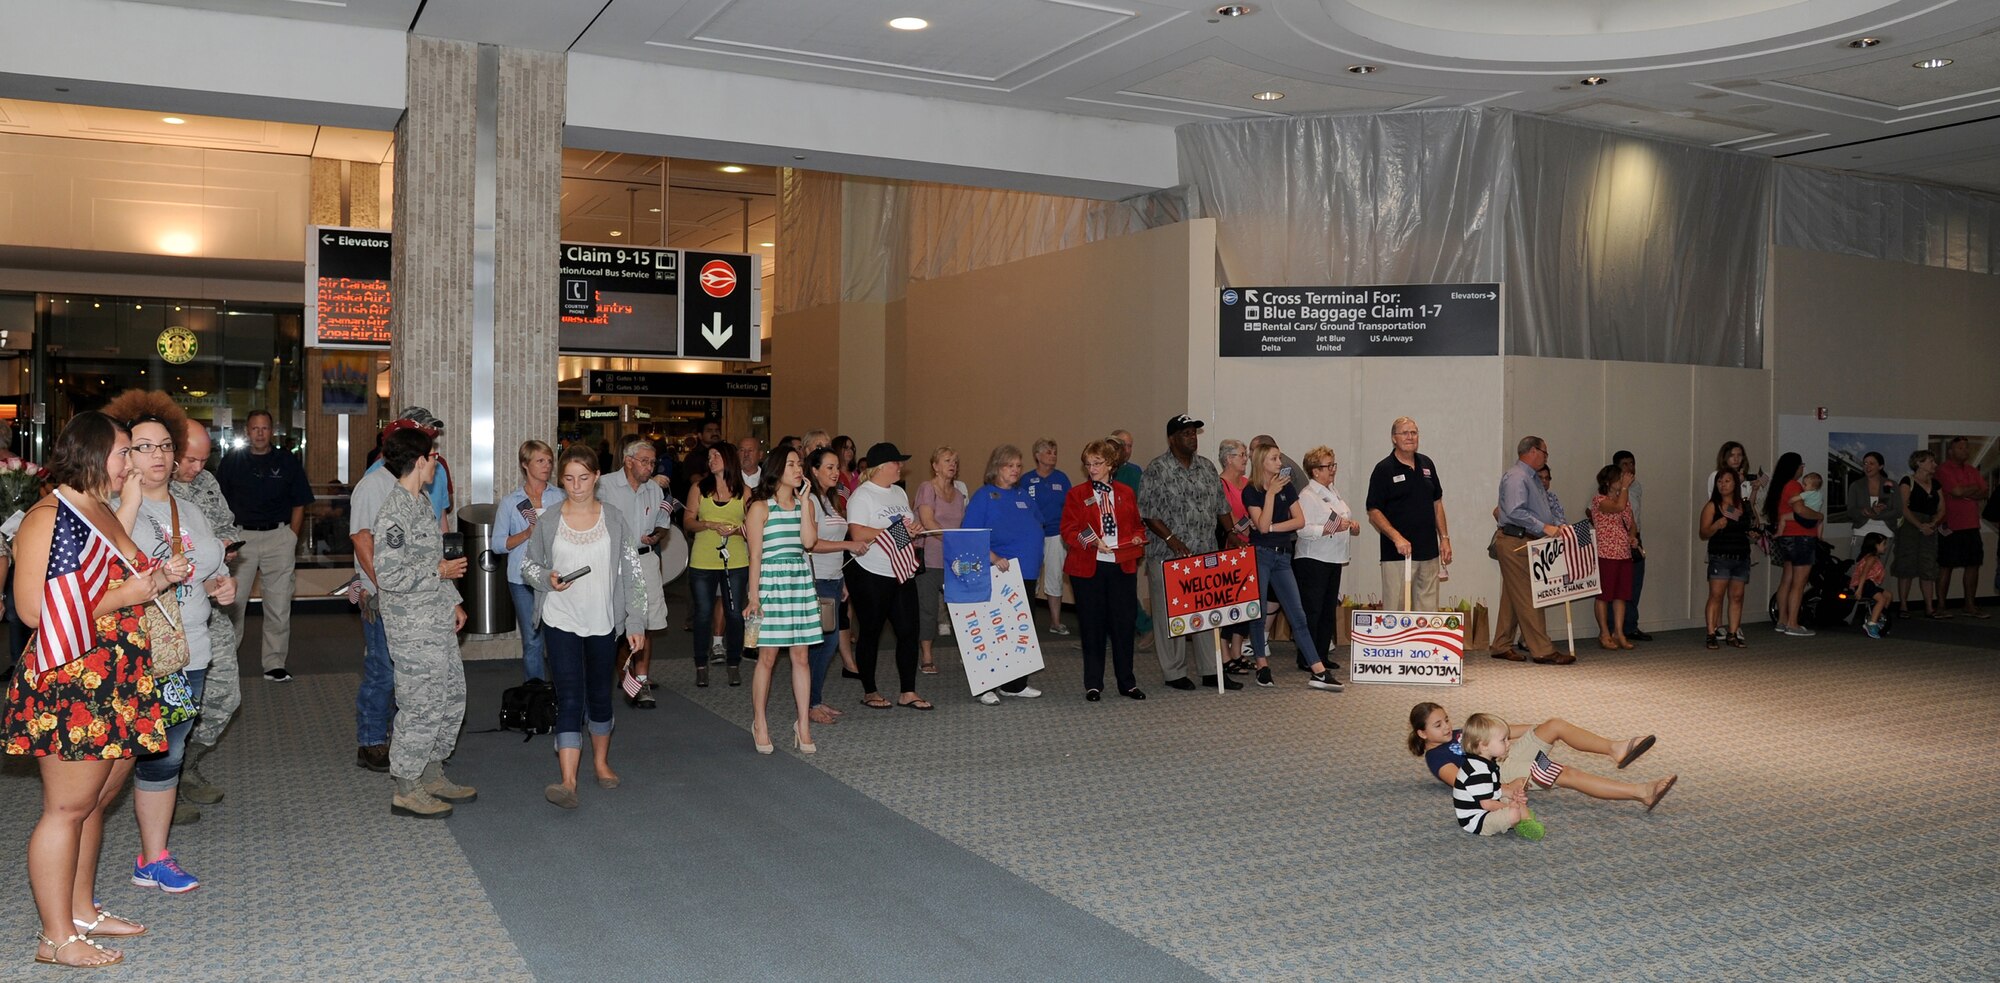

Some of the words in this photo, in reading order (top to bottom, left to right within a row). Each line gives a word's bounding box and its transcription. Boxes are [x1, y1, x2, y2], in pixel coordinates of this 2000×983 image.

[338, 235, 390, 249] Elevators
[566, 246, 612, 264] Claim
[616, 249, 651, 266] 9-15
[604, 268, 620, 278] Bus
[621, 269, 651, 280] Service
[318, 276, 338, 289] Air
[340, 277, 387, 291] Canada
[318, 289, 363, 302] Alaska
[1262, 291, 1302, 305] Cross
[1305, 290, 1368, 305] Terminal
[1373, 290, 1401, 305] For:
[1450, 291, 1487, 301] Elevators
[318, 301, 368, 315] British
[1263, 305, 1297, 320] Blue
[1301, 305, 1367, 322] Baggage
[1371, 304, 1414, 319] Claim
[1419, 303, 1443, 318] 1-7
[1261, 321, 1292, 331] Rental
[1293, 321, 1318, 331] Cars/
[1320, 321, 1355, 331] Ground
[1357, 320, 1427, 332] Transportation
[159, 327, 196, 345] STARBUCKS
[1261, 334, 1297, 343] American
[1316, 334, 1328, 343] Jet
[1328, 334, 1346, 343] Blue
[1369, 334, 1381, 343] US
[1381, 333, 1414, 344] Airways
[1261, 343, 1282, 352] Delta
[1316, 343, 1342, 352] United
[163, 351, 192, 363] COFFEE
[726, 381, 759, 392] Ticketing
[591, 410, 619, 418] Information
[1178, 569, 1241, 595] WELCOME
[1586, 579, 1598, 589] YOU
[1000, 583, 1030, 655] WELCOME
[989, 607, 1008, 644] HOME
[965, 610, 988, 661] TROOPS
[1362, 647, 1404, 658] HEROES
[1410, 649, 1432, 659] OUR
[1353, 663, 1392, 675] HOME!
[1398, 664, 1461, 677] WELCOME
